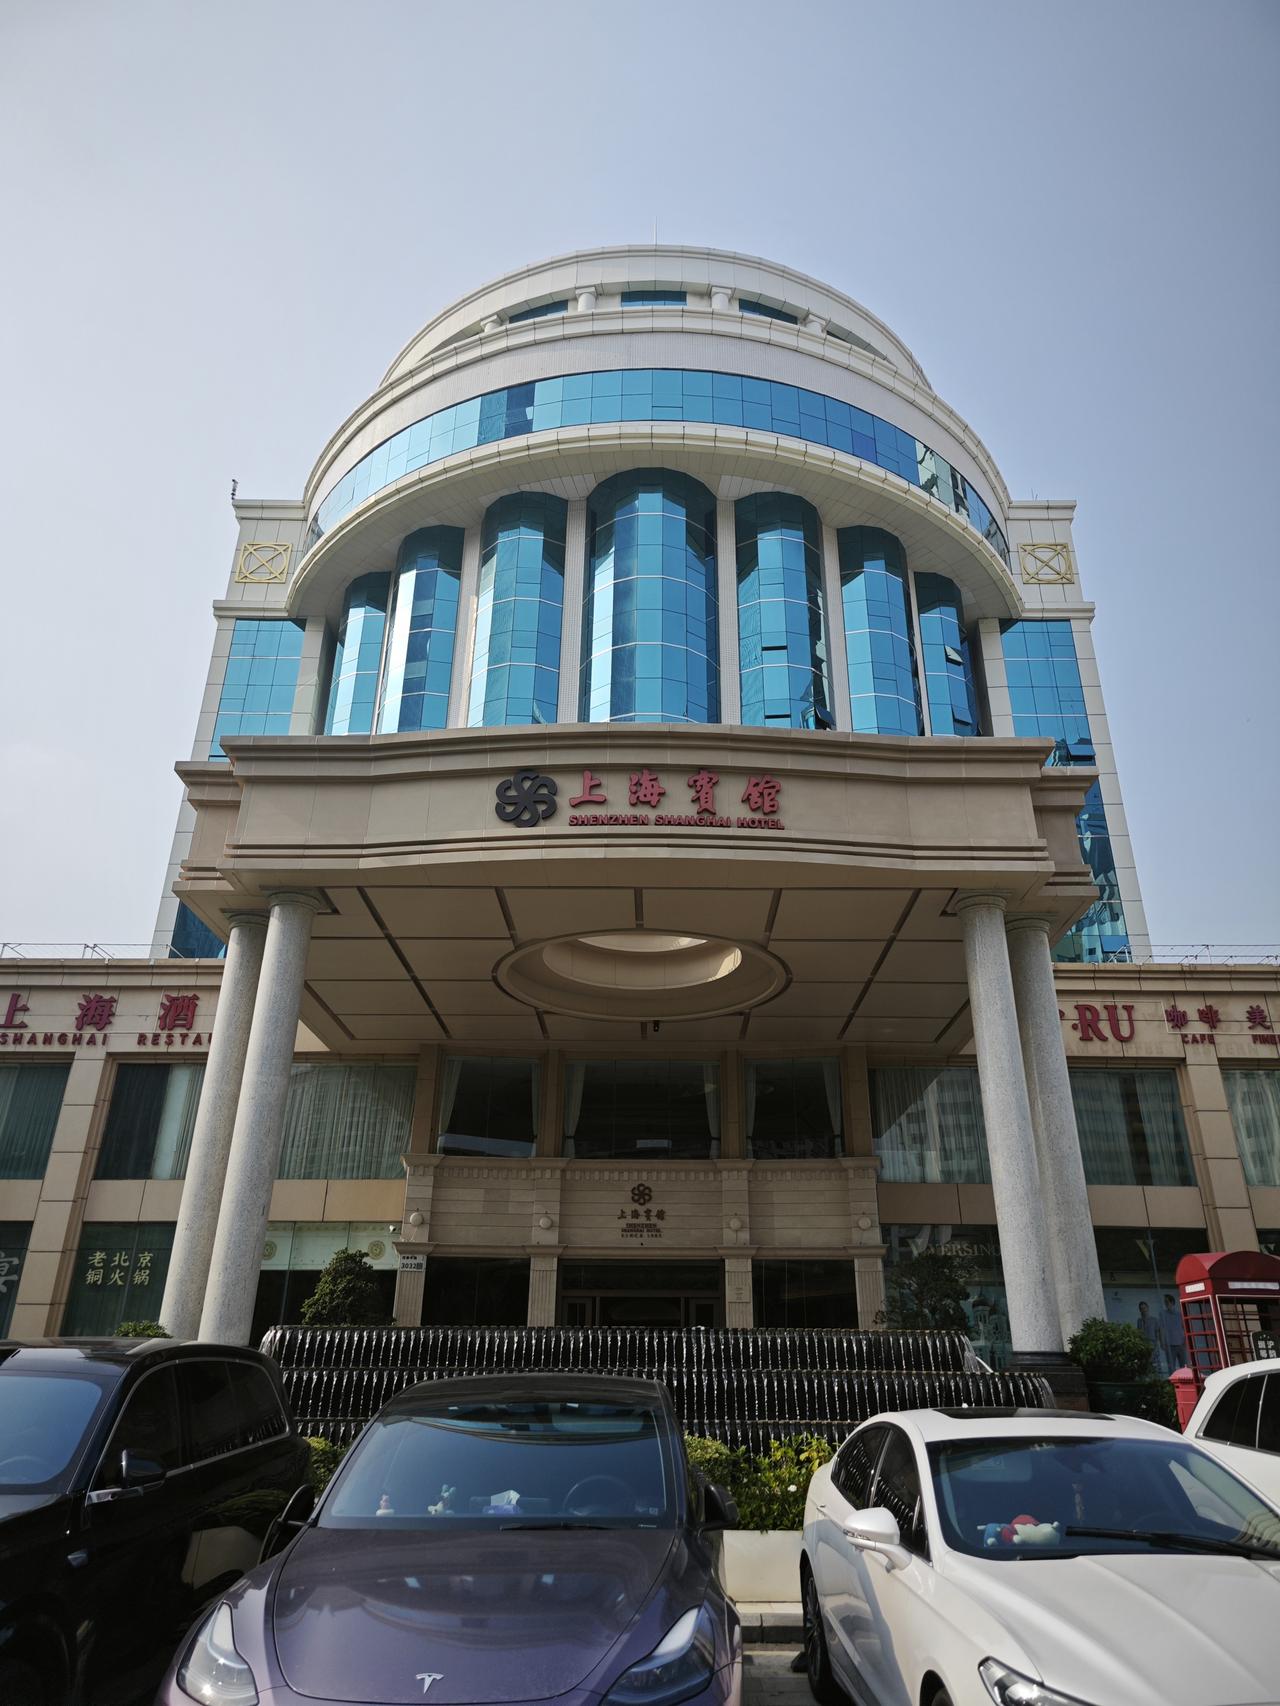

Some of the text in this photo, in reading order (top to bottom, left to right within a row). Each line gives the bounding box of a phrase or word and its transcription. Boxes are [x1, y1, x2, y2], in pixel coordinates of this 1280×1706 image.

[568, 769, 784, 815] 上海賓館
[568, 814, 785, 830] SHENZHEN SHANGHAI HOTEL
[1165, 1005, 1221, 1030] 咖啡
[0, 1033, 213, 1046] SHANGHAI RESTA
[87, 1251, 154, 1267] 老北京
[84, 1268, 150, 1286] 铜火锅
